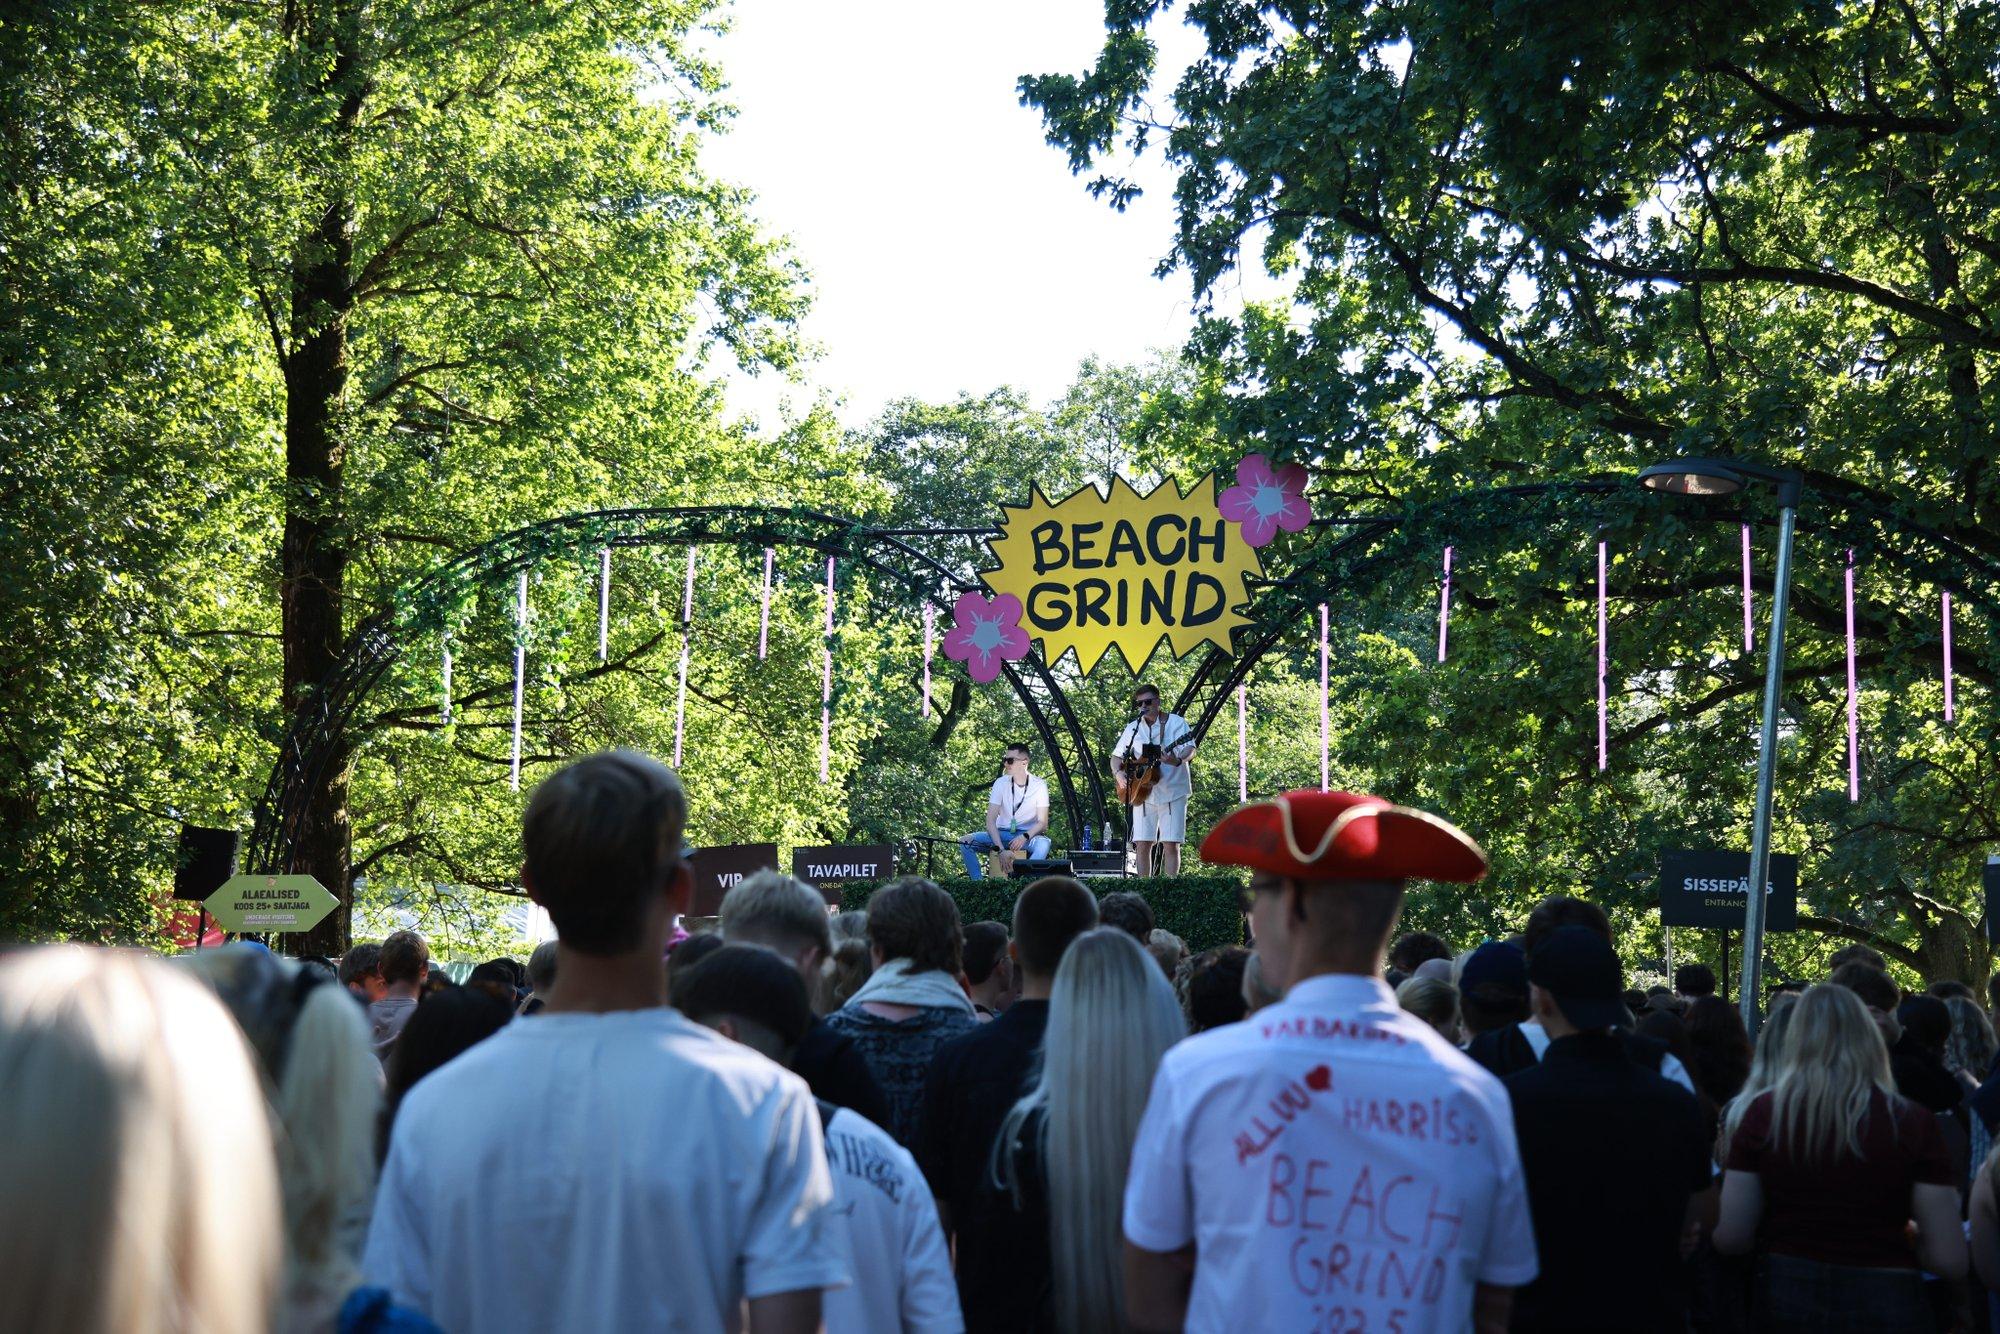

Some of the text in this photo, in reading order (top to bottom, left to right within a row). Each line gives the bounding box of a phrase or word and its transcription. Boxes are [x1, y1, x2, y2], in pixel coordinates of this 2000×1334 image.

[1031, 514, 1225, 575] BEACH
[1026, 569, 1226, 631] GRIND
[807, 864, 877, 878] TAVAPILET
[717, 873, 743, 888] VIP
[1683, 877, 1774, 895] SISSEPÄS
[242, 889, 300, 900] ALAEALISED
[234, 901, 310, 910] KOOS 25+ SAATJAGA
[1705, 898, 1747, 908] ENTRANC
[1266, 1153, 1467, 1250] BEACH
[1289, 1236, 1447, 1304] GRIND
